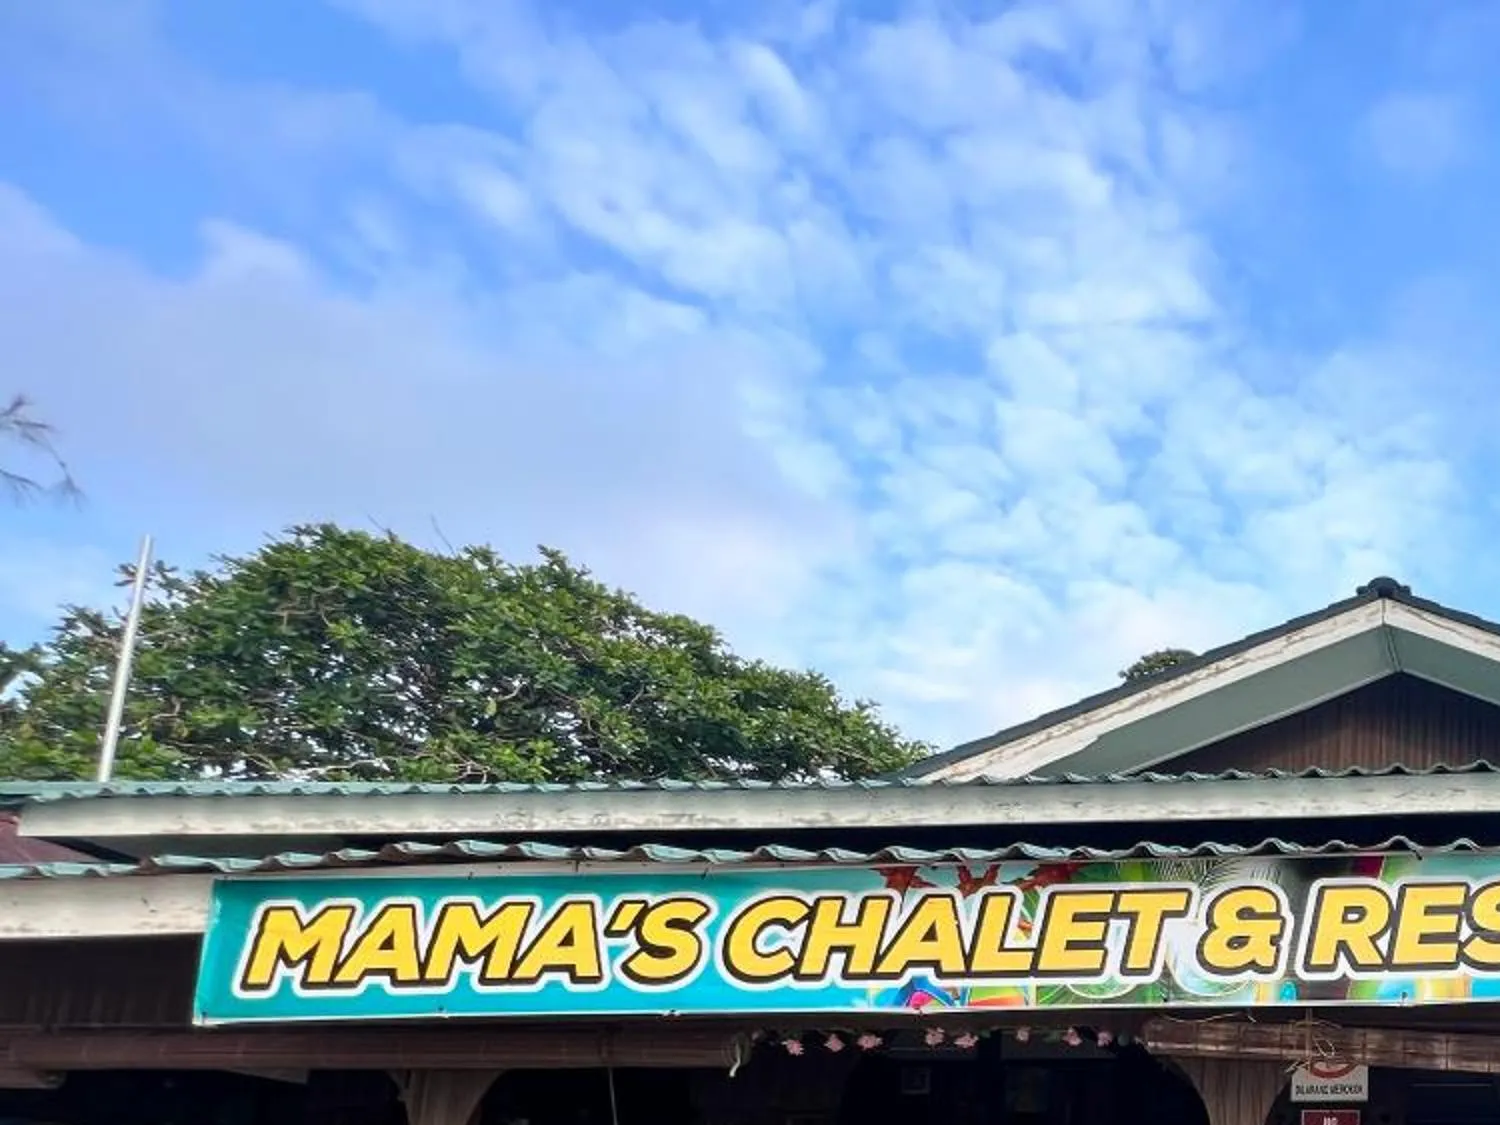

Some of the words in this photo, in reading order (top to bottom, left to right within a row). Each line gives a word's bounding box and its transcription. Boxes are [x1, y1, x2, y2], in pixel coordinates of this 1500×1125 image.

[240, 896, 712, 991] MAMA'S
[721, 887, 1197, 979] CHALET
[1197, 885, 1287, 978] &
